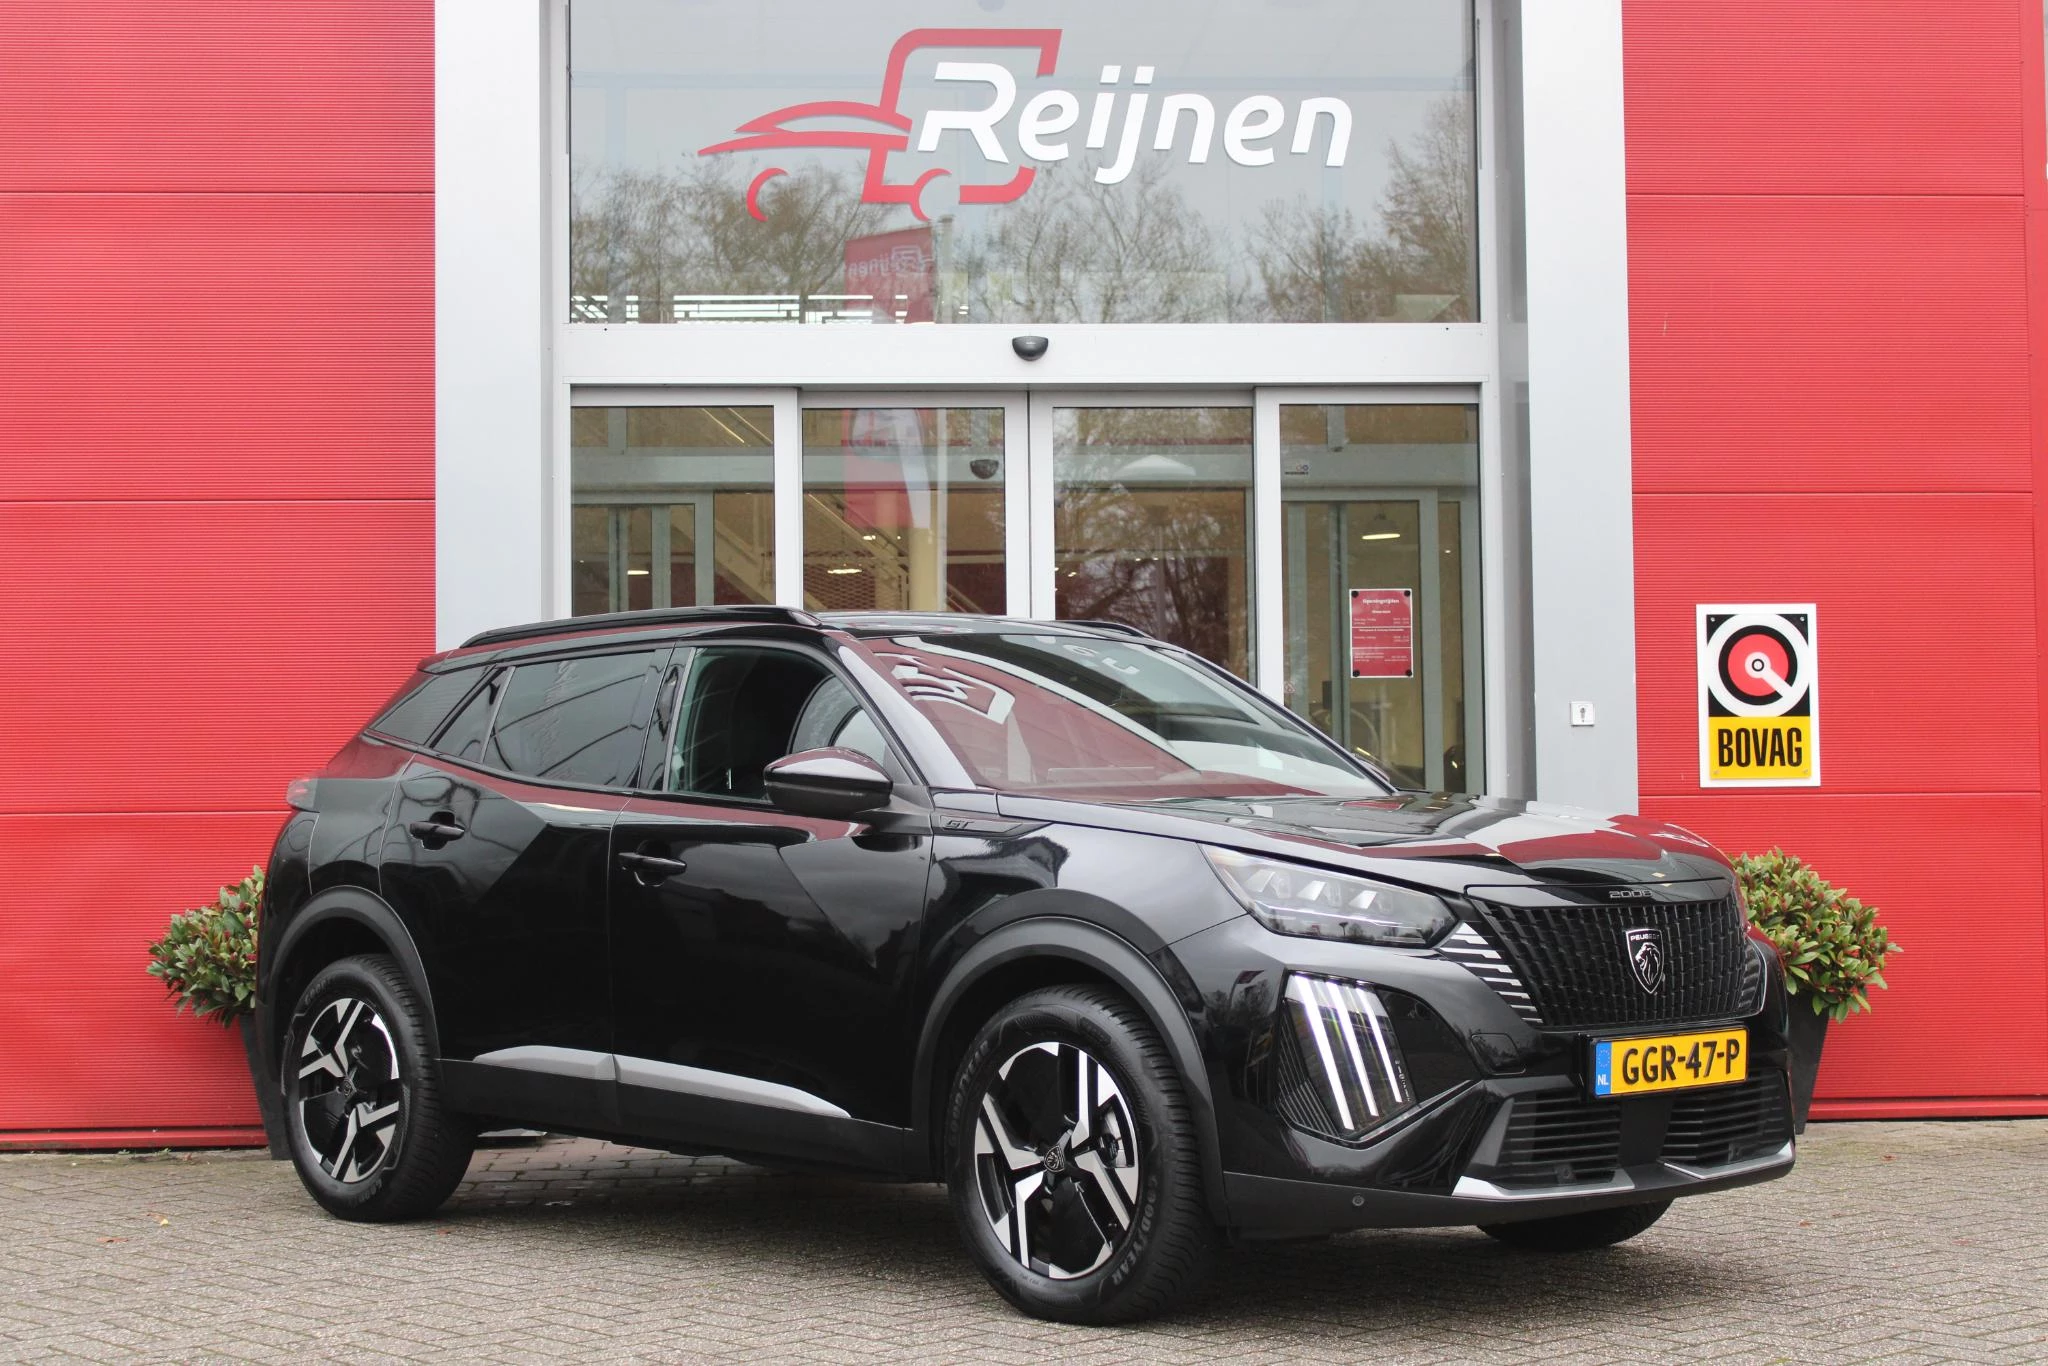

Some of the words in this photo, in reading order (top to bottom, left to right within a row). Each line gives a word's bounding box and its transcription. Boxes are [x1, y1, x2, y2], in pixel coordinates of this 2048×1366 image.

[917, 61, 1353, 185] Reijnen
[1717, 727, 1803, 768] BOVAG
[945, 820, 974, 828] GT
[1608, 889, 1653, 899] 2008
[1622, 1038, 1741, 1086] GGR-47-P
[1597, 1073, 1609, 1086] NL
